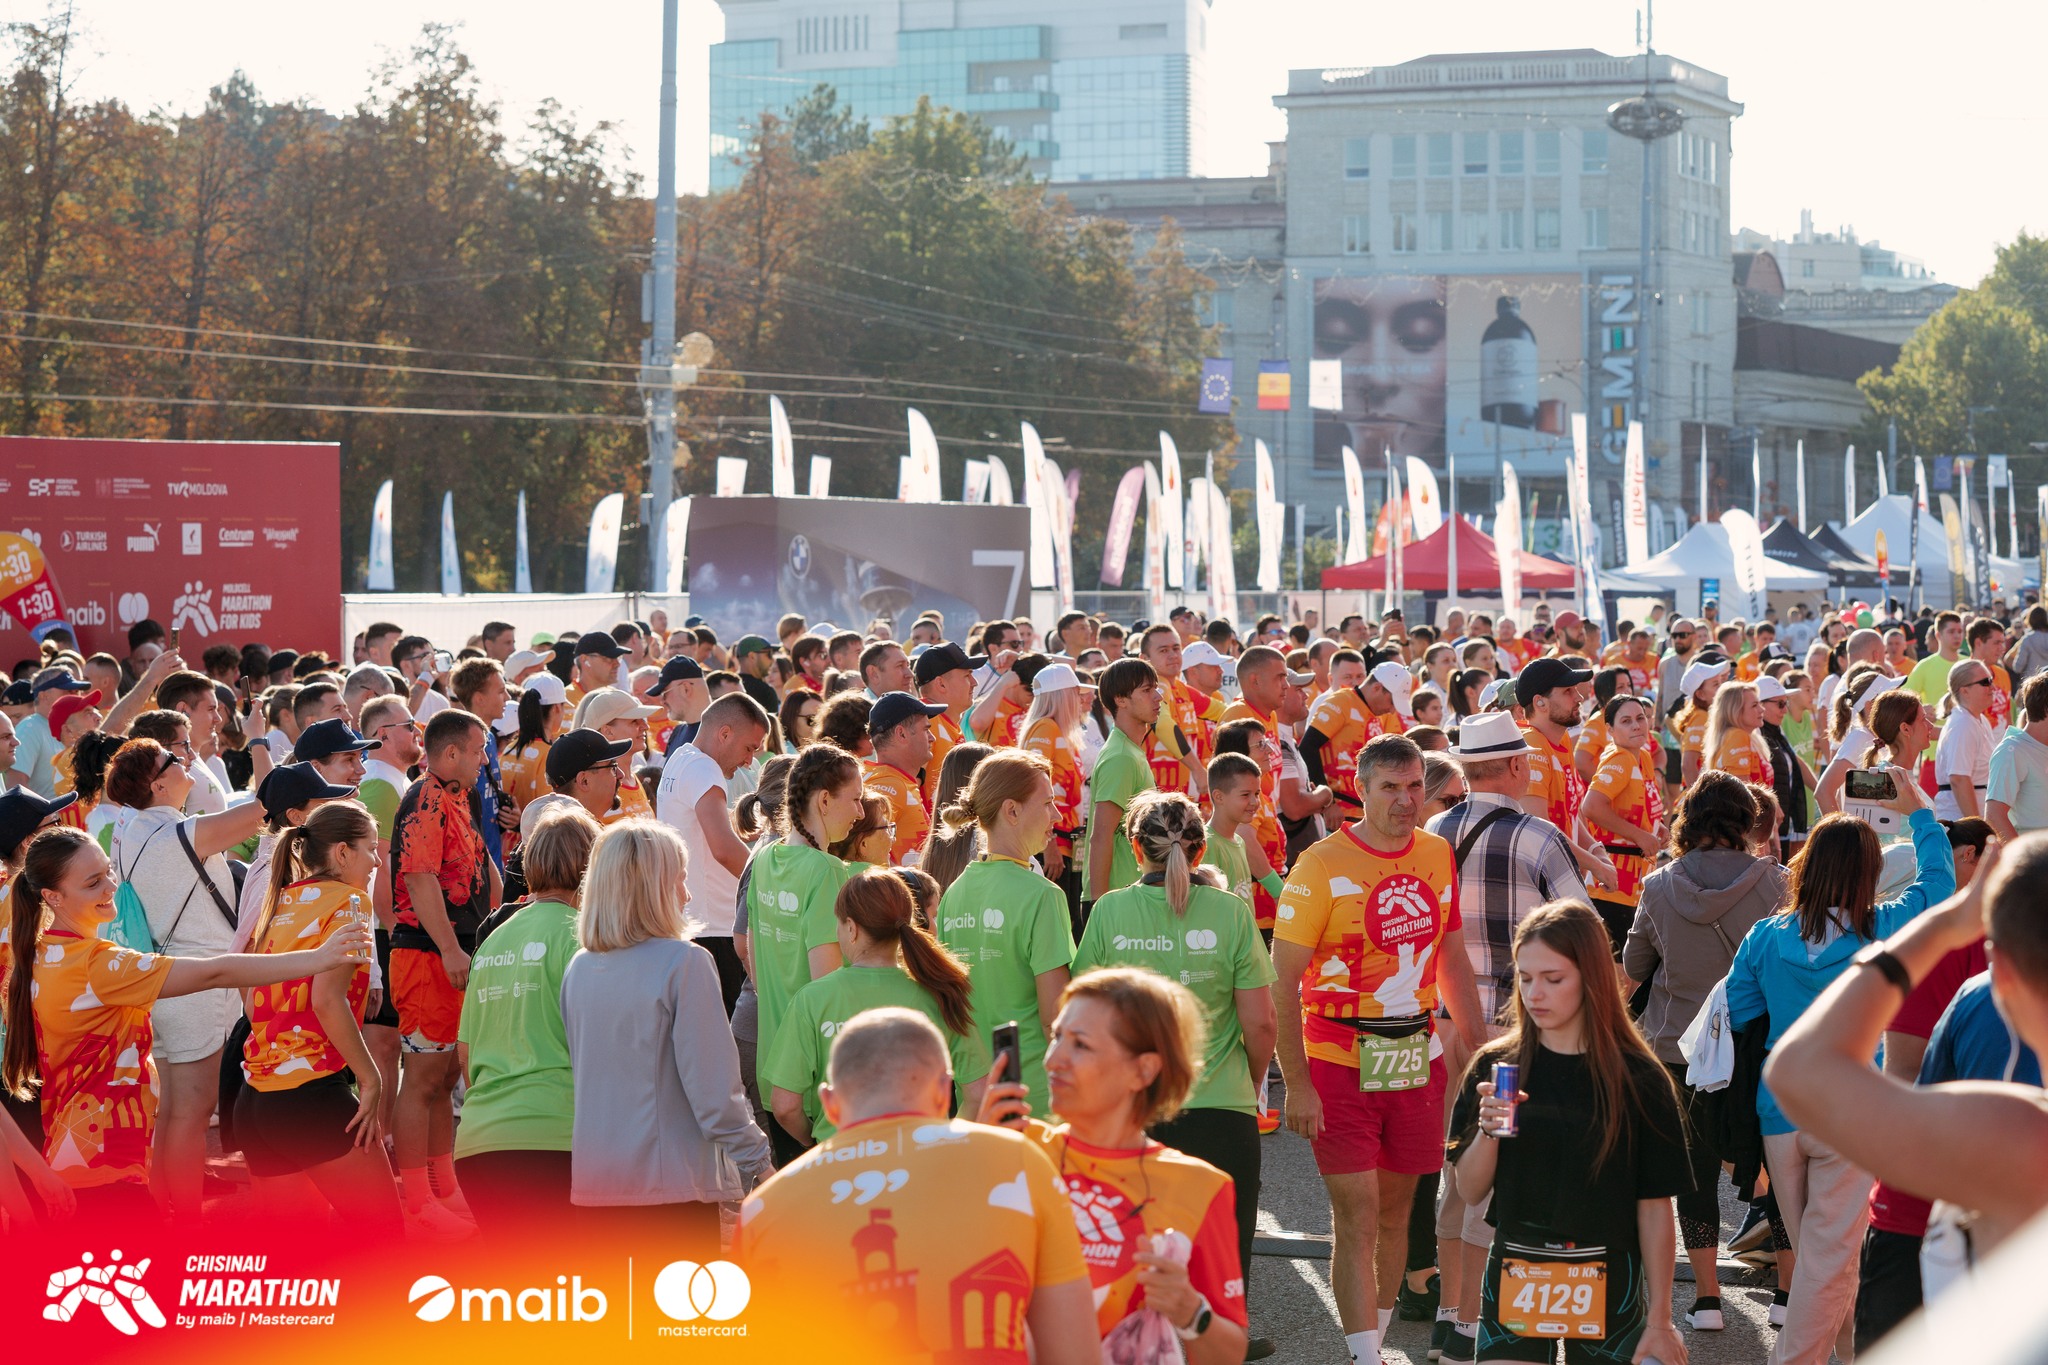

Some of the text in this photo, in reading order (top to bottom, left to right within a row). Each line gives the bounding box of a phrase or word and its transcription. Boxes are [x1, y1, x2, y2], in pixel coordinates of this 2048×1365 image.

[189, 484, 228, 495] MOLDOVA
[76, 531, 107, 541] TURKISH
[218, 527, 255, 541] Centrum
[75, 542, 108, 552] AIRLINES
[127, 536, 155, 552] PUMA
[972, 550, 1025, 622] 7
[17, 590, 54, 620] 1:30
[221, 594, 272, 612] MARATHON
[220, 612, 262, 630] FOR KIDS
[1284, 883, 1311, 897] maib
[1381, 914, 1408, 928] CHISINAU
[1382, 915, 1433, 940] MARATHON
[1405, 928, 1433, 939] Mastercard
[1127, 935, 1174, 951] maib
[481, 950, 516, 968] maib
[1409, 1034, 1425, 1044] 5 KM
[1371, 1047, 1423, 1075] 7725
[1568, 1267, 1599, 1278] 10 KM
[1512, 1282, 1593, 1315] 4129
